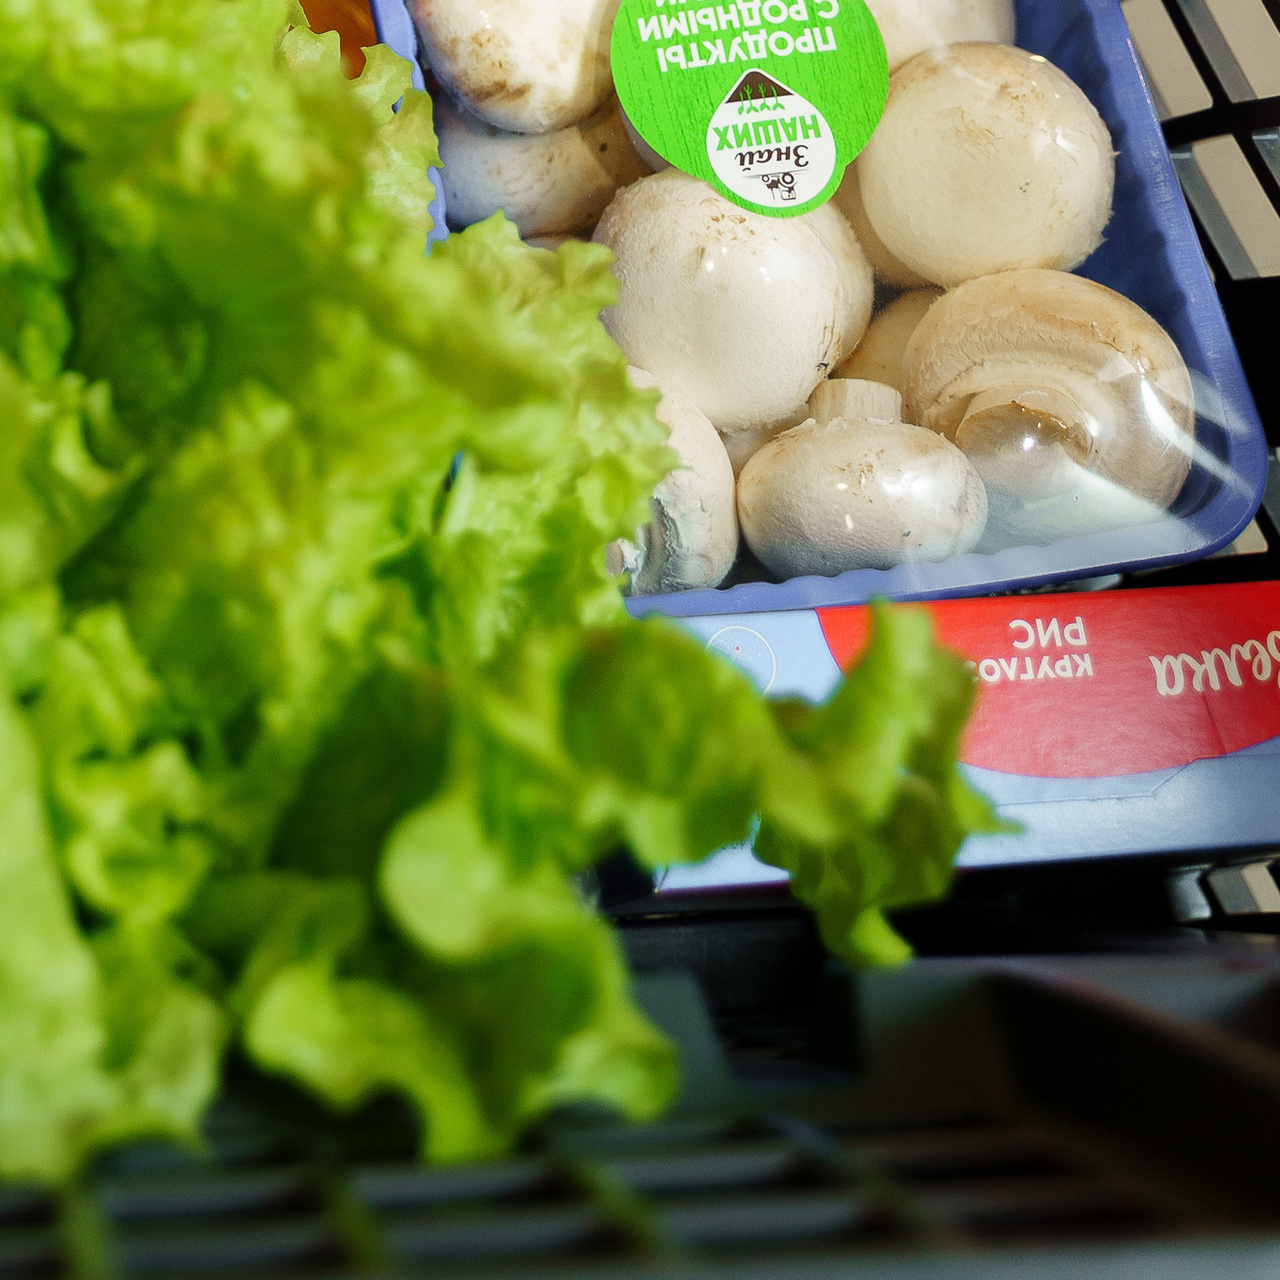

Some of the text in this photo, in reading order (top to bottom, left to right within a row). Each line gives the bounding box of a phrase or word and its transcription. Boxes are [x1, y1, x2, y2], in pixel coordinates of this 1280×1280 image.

[656, 25, 838, 73] ПРОДУКТЫ
[712, 113, 822, 151] НАШИХ
[734, 143, 810, 173] Знай
[1008, 615, 1089, 650] РИС
